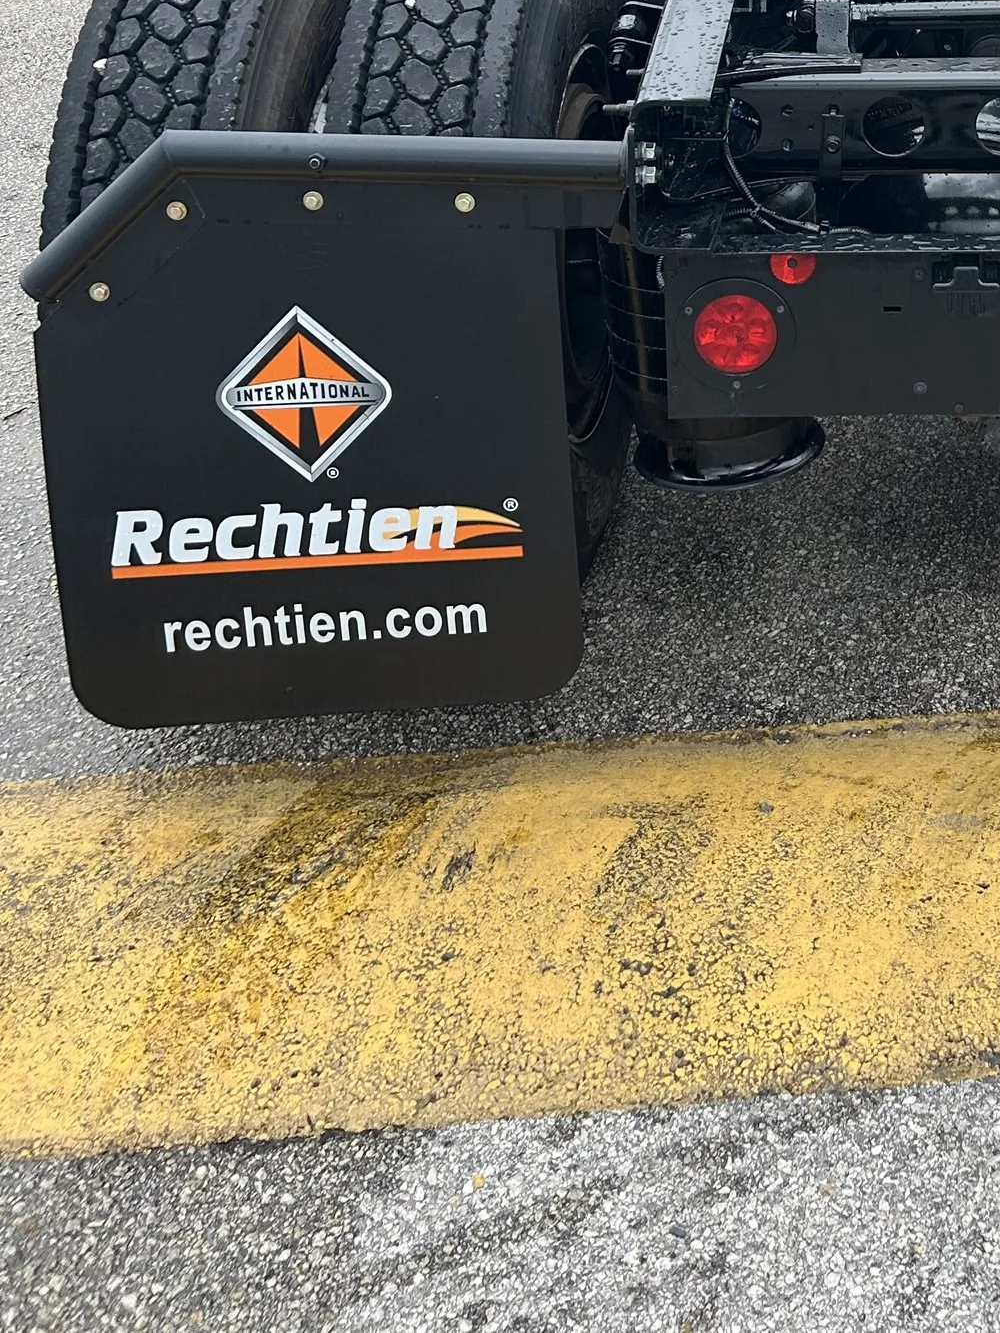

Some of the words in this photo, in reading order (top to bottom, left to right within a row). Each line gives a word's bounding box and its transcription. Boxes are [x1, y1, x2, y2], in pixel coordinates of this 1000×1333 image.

[236, 382, 370, 403] INTERNATIONAL
[111, 498, 462, 568] Rechtien
[163, 603, 488, 654] rechtien.com
